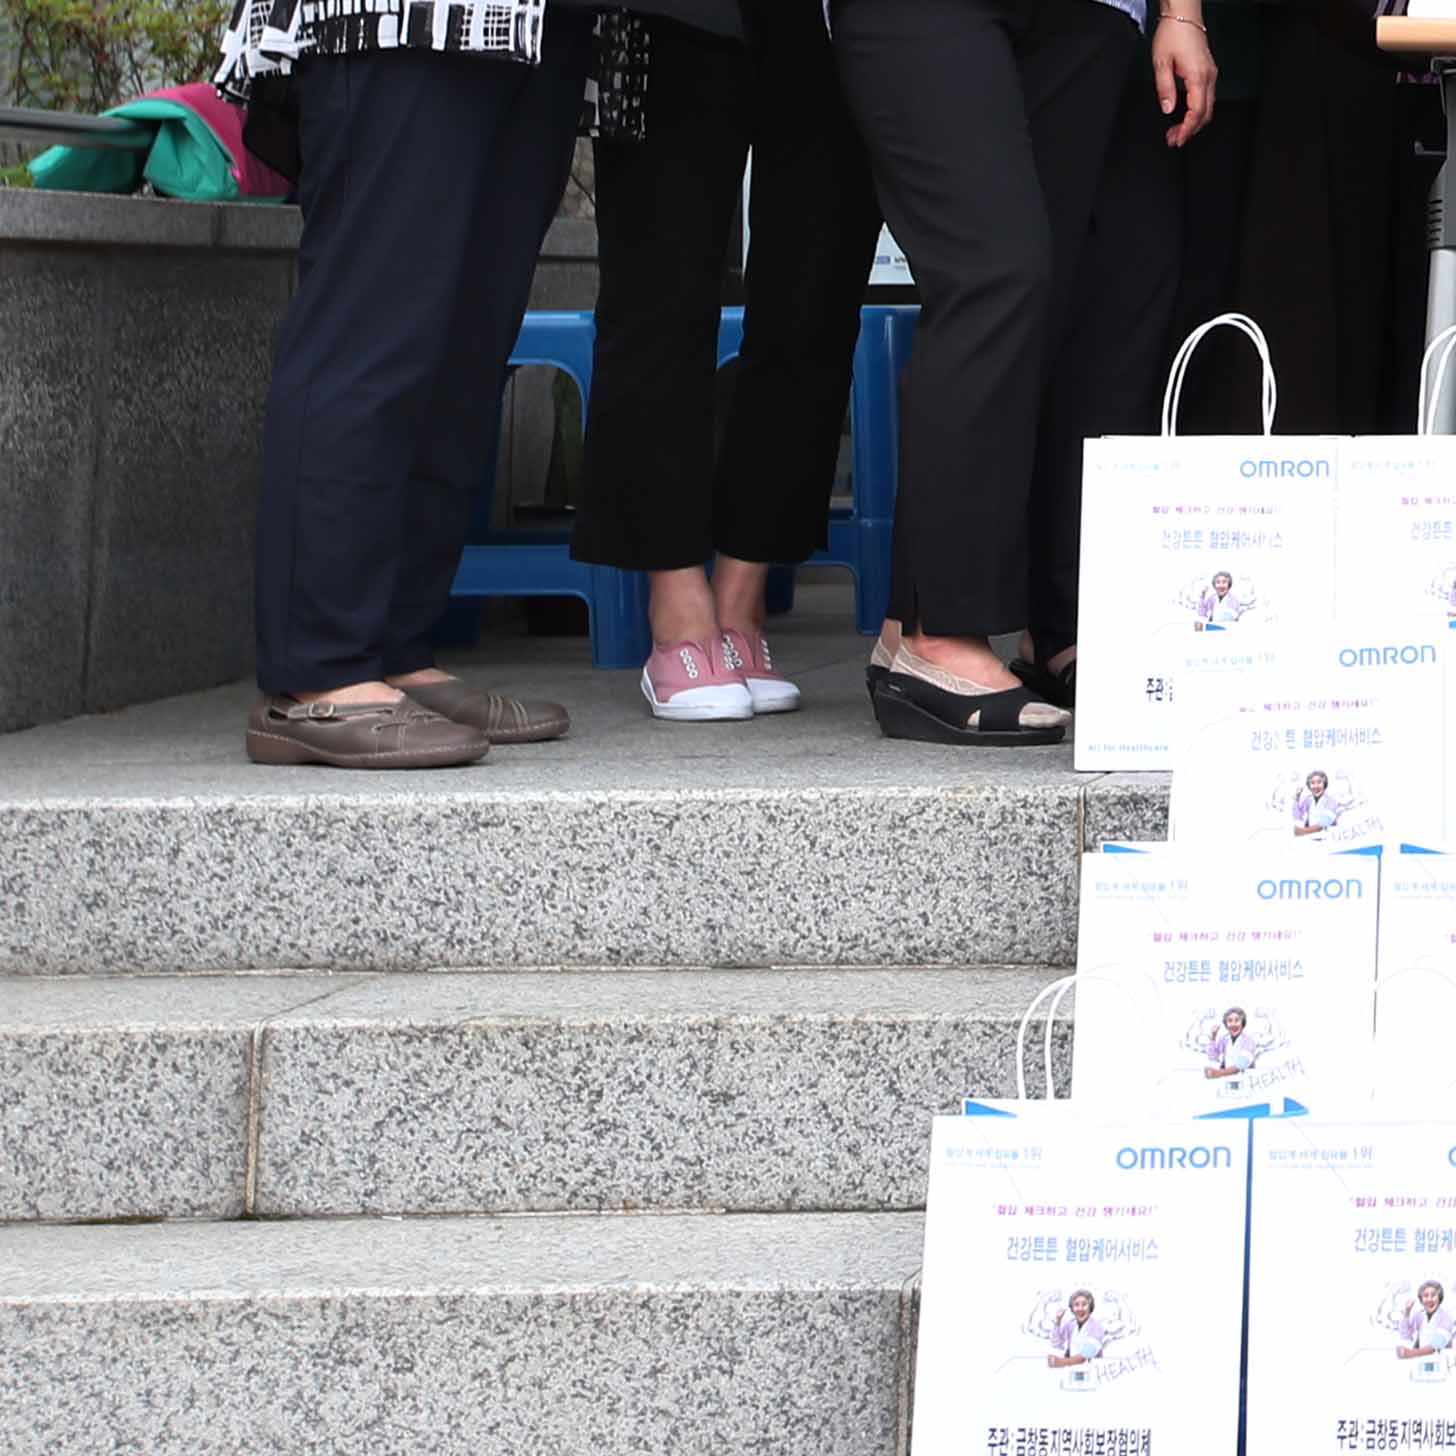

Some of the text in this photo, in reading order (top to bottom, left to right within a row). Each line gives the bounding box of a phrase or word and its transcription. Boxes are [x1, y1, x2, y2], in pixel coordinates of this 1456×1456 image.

[1239, 459, 1330, 479] OMRON
[1337, 644, 1437, 668] OMRON
[1256, 878, 1364, 901] OMRON
[1115, 1145, 1232, 1171] OMRON
[1006, 1232, 1159, 1265] 건강튼튼 혈압케어서비스
[1354, 1226, 1409, 1255] 건강튼튼
